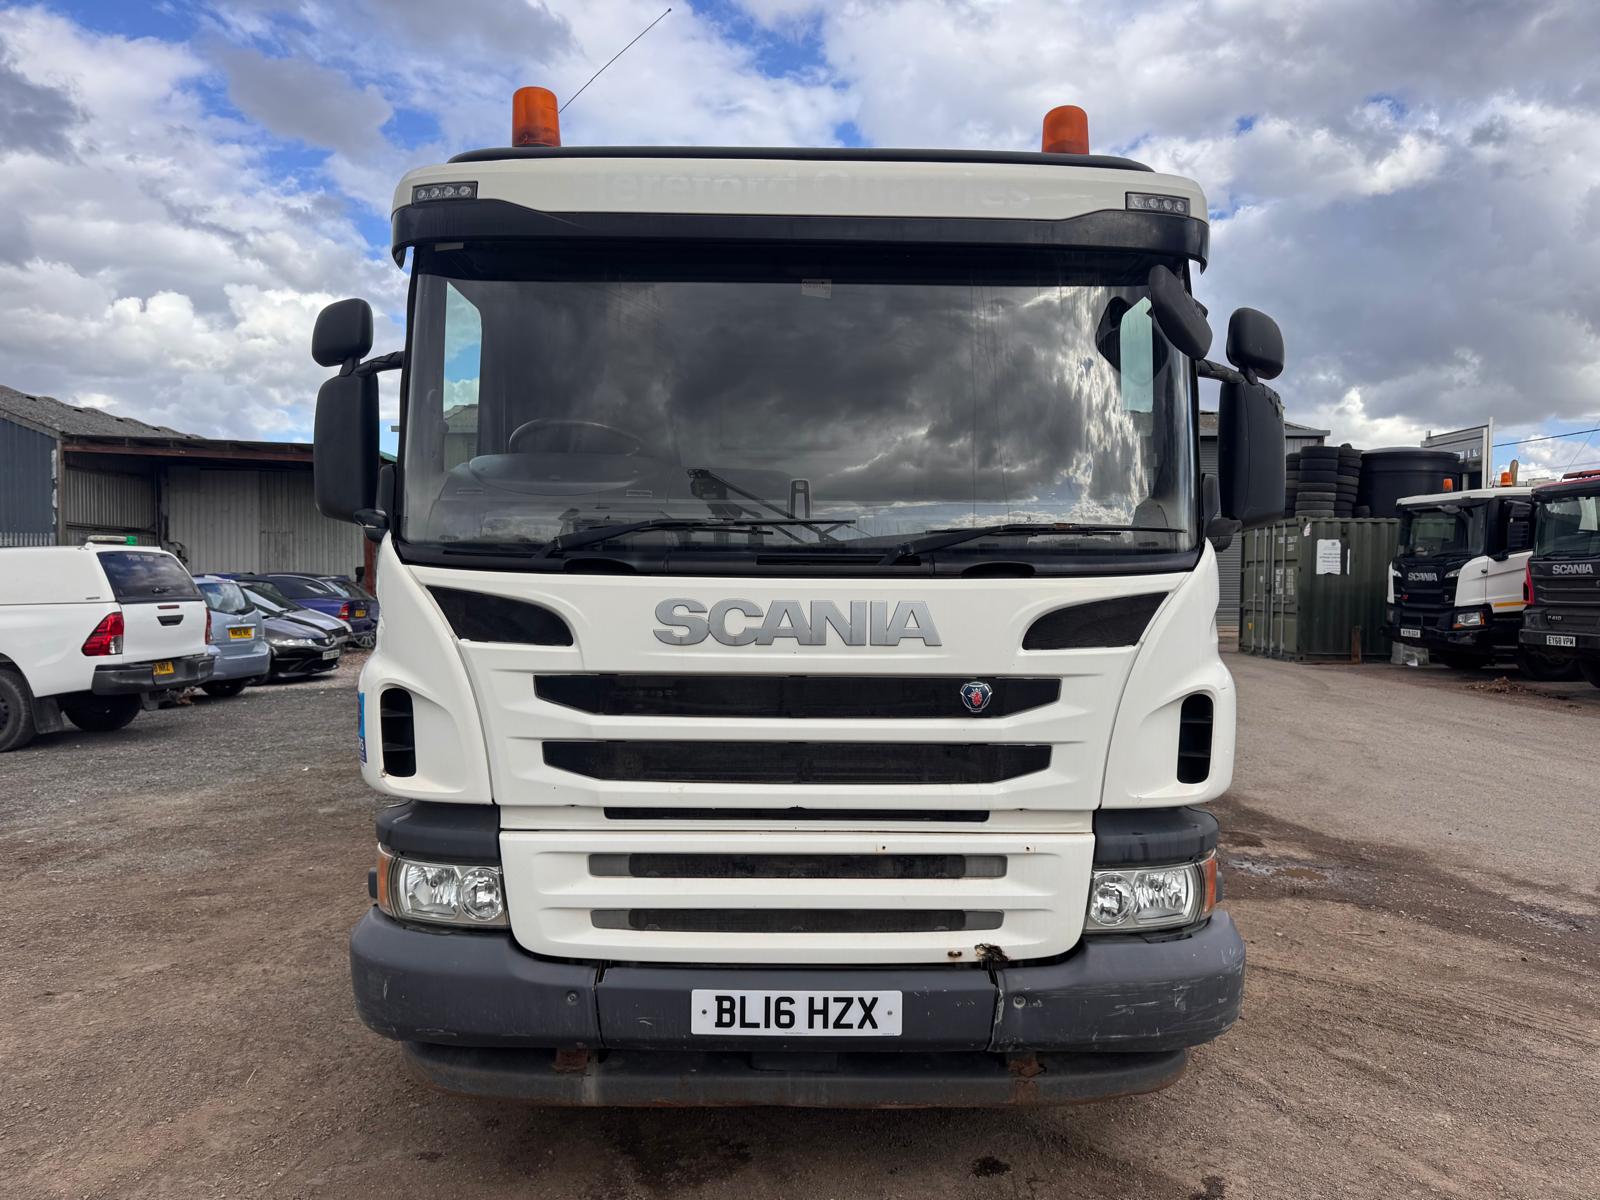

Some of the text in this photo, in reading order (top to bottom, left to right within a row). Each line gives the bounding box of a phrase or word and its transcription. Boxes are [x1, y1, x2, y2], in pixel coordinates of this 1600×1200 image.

[1408, 572, 1438, 581] SCANIA
[1552, 564, 1593, 575] SCANIA
[653, 598, 943, 646] SCANIA
[714, 995, 879, 1030] BL16 HZX
